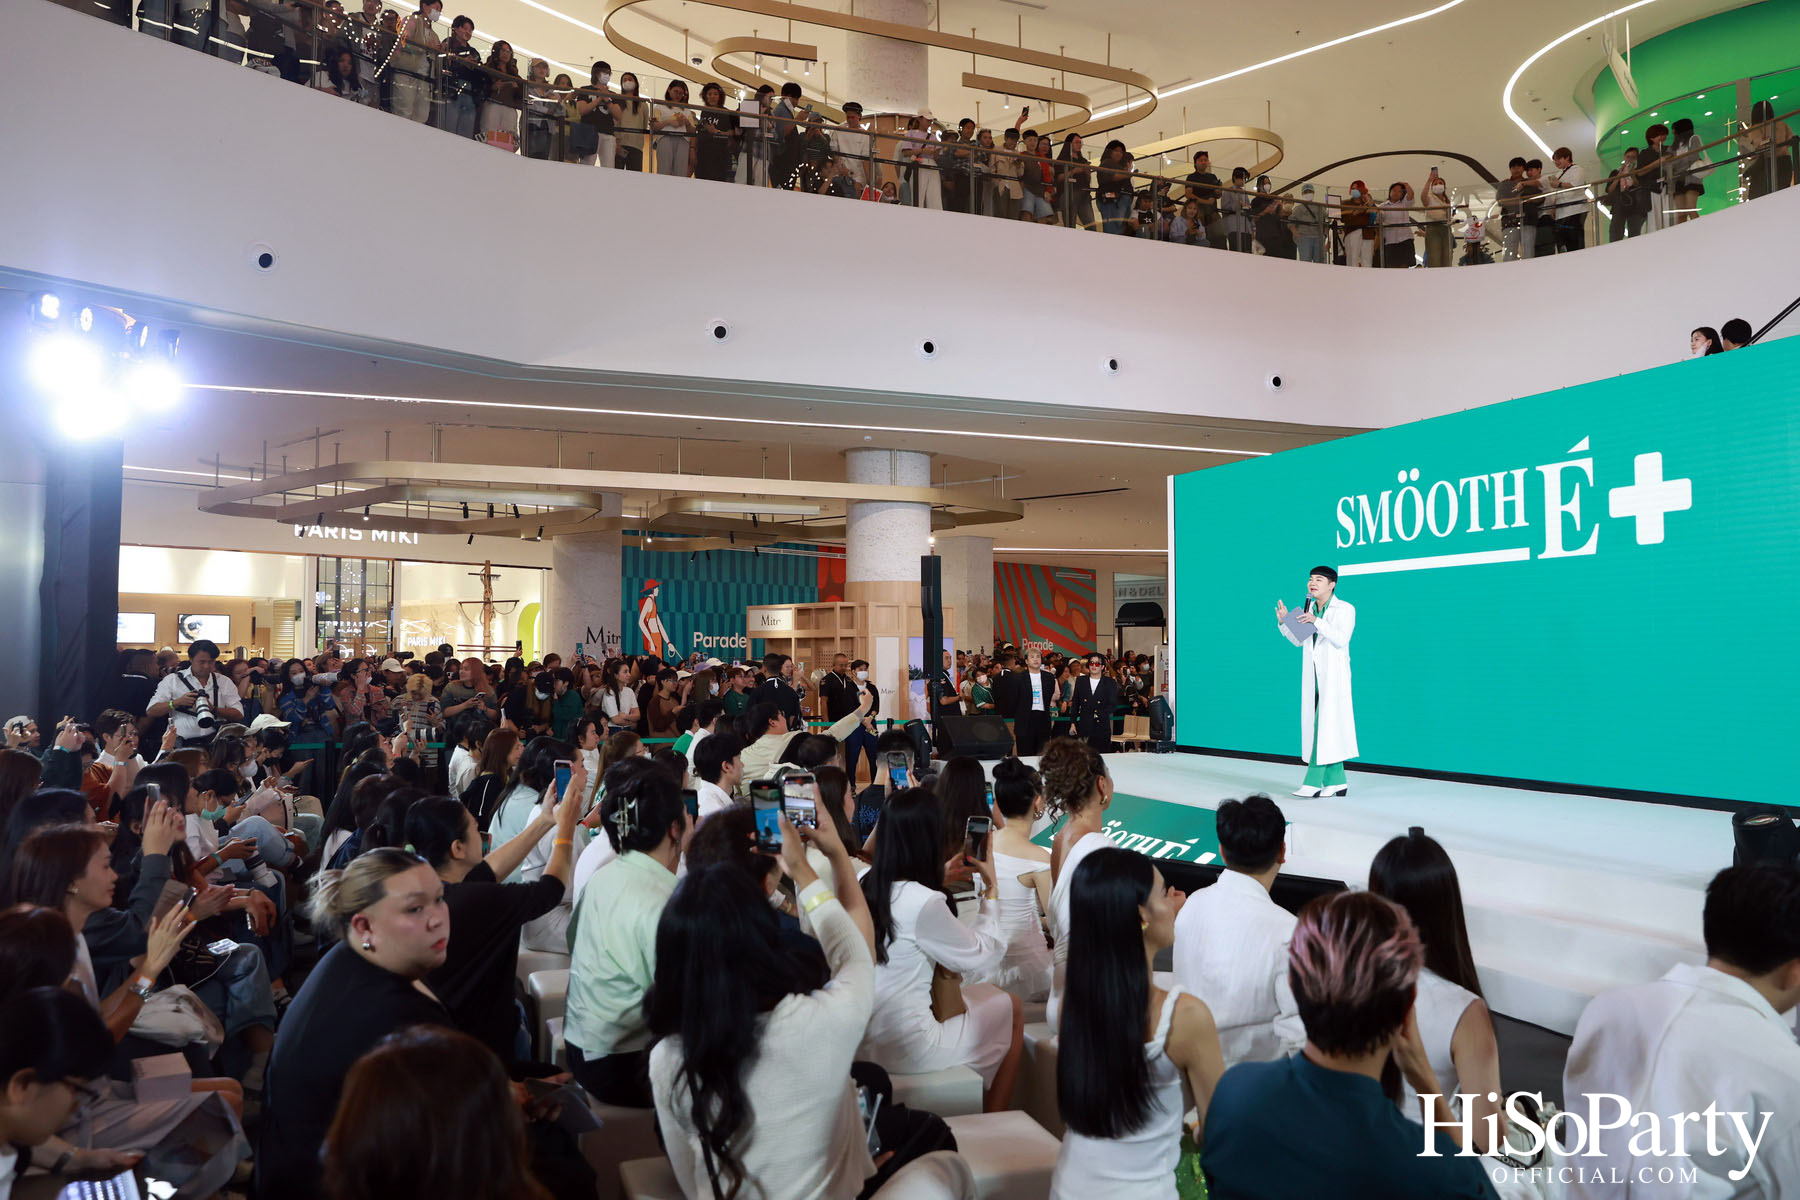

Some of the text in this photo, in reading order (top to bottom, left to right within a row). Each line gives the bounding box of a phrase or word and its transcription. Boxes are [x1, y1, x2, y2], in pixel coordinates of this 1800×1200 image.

[294, 524, 418, 545] PARIS MIKI
[693, 631, 747, 649] Parade
